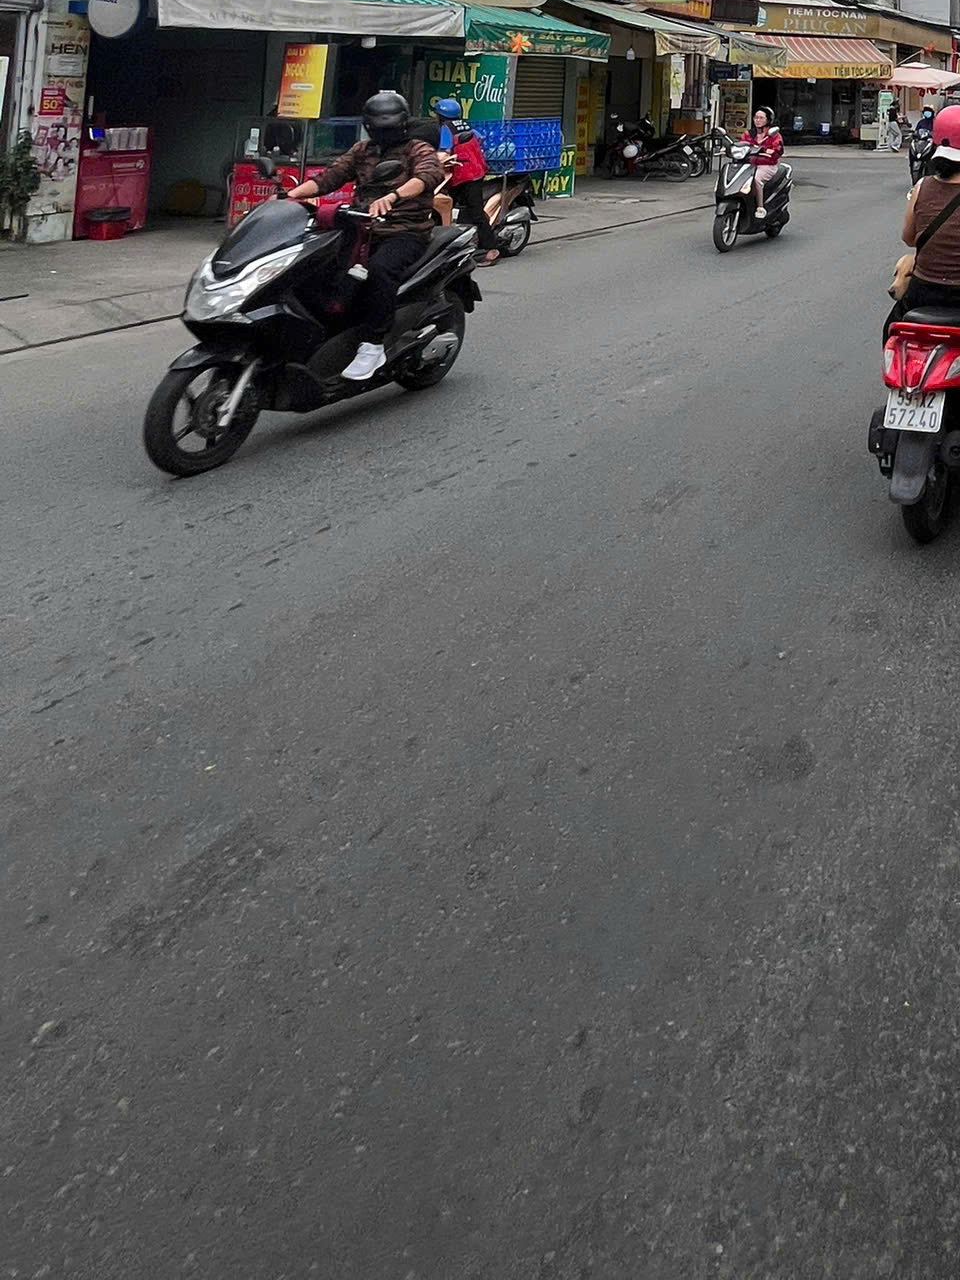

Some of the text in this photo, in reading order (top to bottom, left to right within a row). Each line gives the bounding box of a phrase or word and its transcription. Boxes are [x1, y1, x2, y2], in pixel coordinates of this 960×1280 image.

[786, 7, 813, 17] TIỆM
[841, 10, 867, 20] NAM
[888, 408, 938, 428] 572.40
